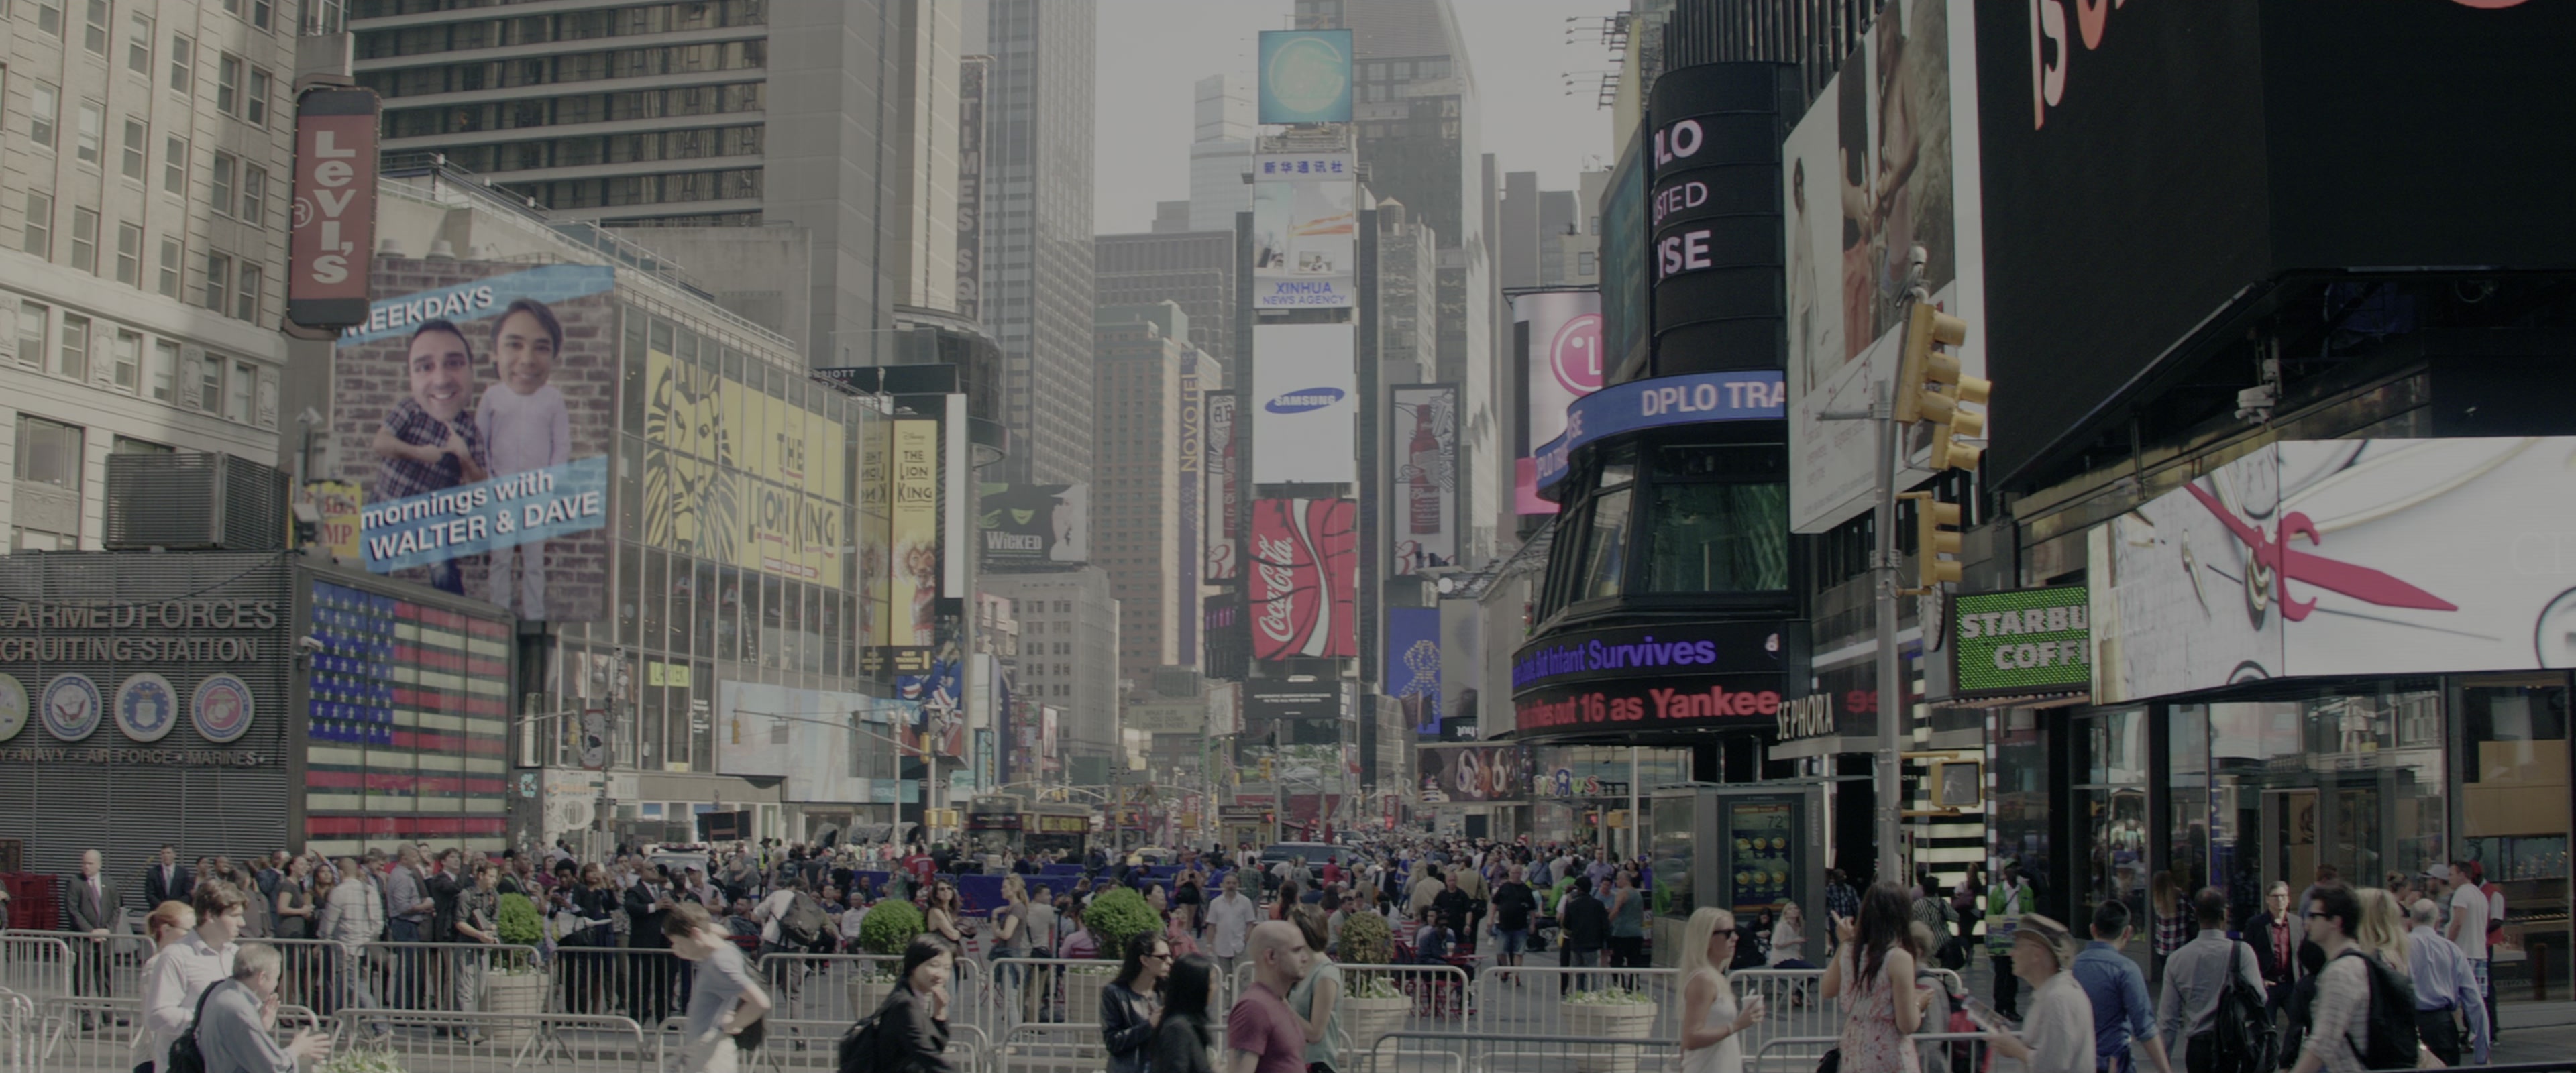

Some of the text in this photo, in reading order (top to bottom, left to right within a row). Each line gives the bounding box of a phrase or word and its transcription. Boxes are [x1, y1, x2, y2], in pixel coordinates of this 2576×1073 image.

[958, 98, 977, 231] TIMES
[1264, 160, 1342, 174] 新华通讯社
[1263, 295, 1345, 305] NEWS AGENCY
[1276, 282, 1332, 294] XINHUA
[1273, 394, 1337, 407] SAMSUNG
[1641, 382, 1717, 416] DPLO
[1181, 365, 1197, 472] NOVOTEL
[777, 433, 805, 471] THE
[904, 451, 924, 459] THE
[900, 463, 928, 479] LION
[360, 489, 488, 532] mornings
[494, 471, 553, 503] with
[898, 482, 932, 502] KING
[370, 518, 488, 561] WALTER
[496, 510, 515, 534] &
[524, 490, 600, 528] DAVE
[748, 466, 835, 554] LION KING
[14, 600, 277, 629] ARMED FORCES
[0, 638, 257, 661] CRUITING STATION
[1550, 644, 1585, 675] Infant
[1589, 636, 1716, 671] Survives
[1580, 692, 1605, 722] 16
[1610, 697, 1644, 721] as
[1649, 686, 1780, 719] Yankee
[1776, 692, 1835, 740] SEPHORA
[22, 749, 67, 761] NAVY
[87, 749, 110, 762] AIR
[120, 749, 176, 764] FORCE
[189, 751, 256, 765] MARINES
